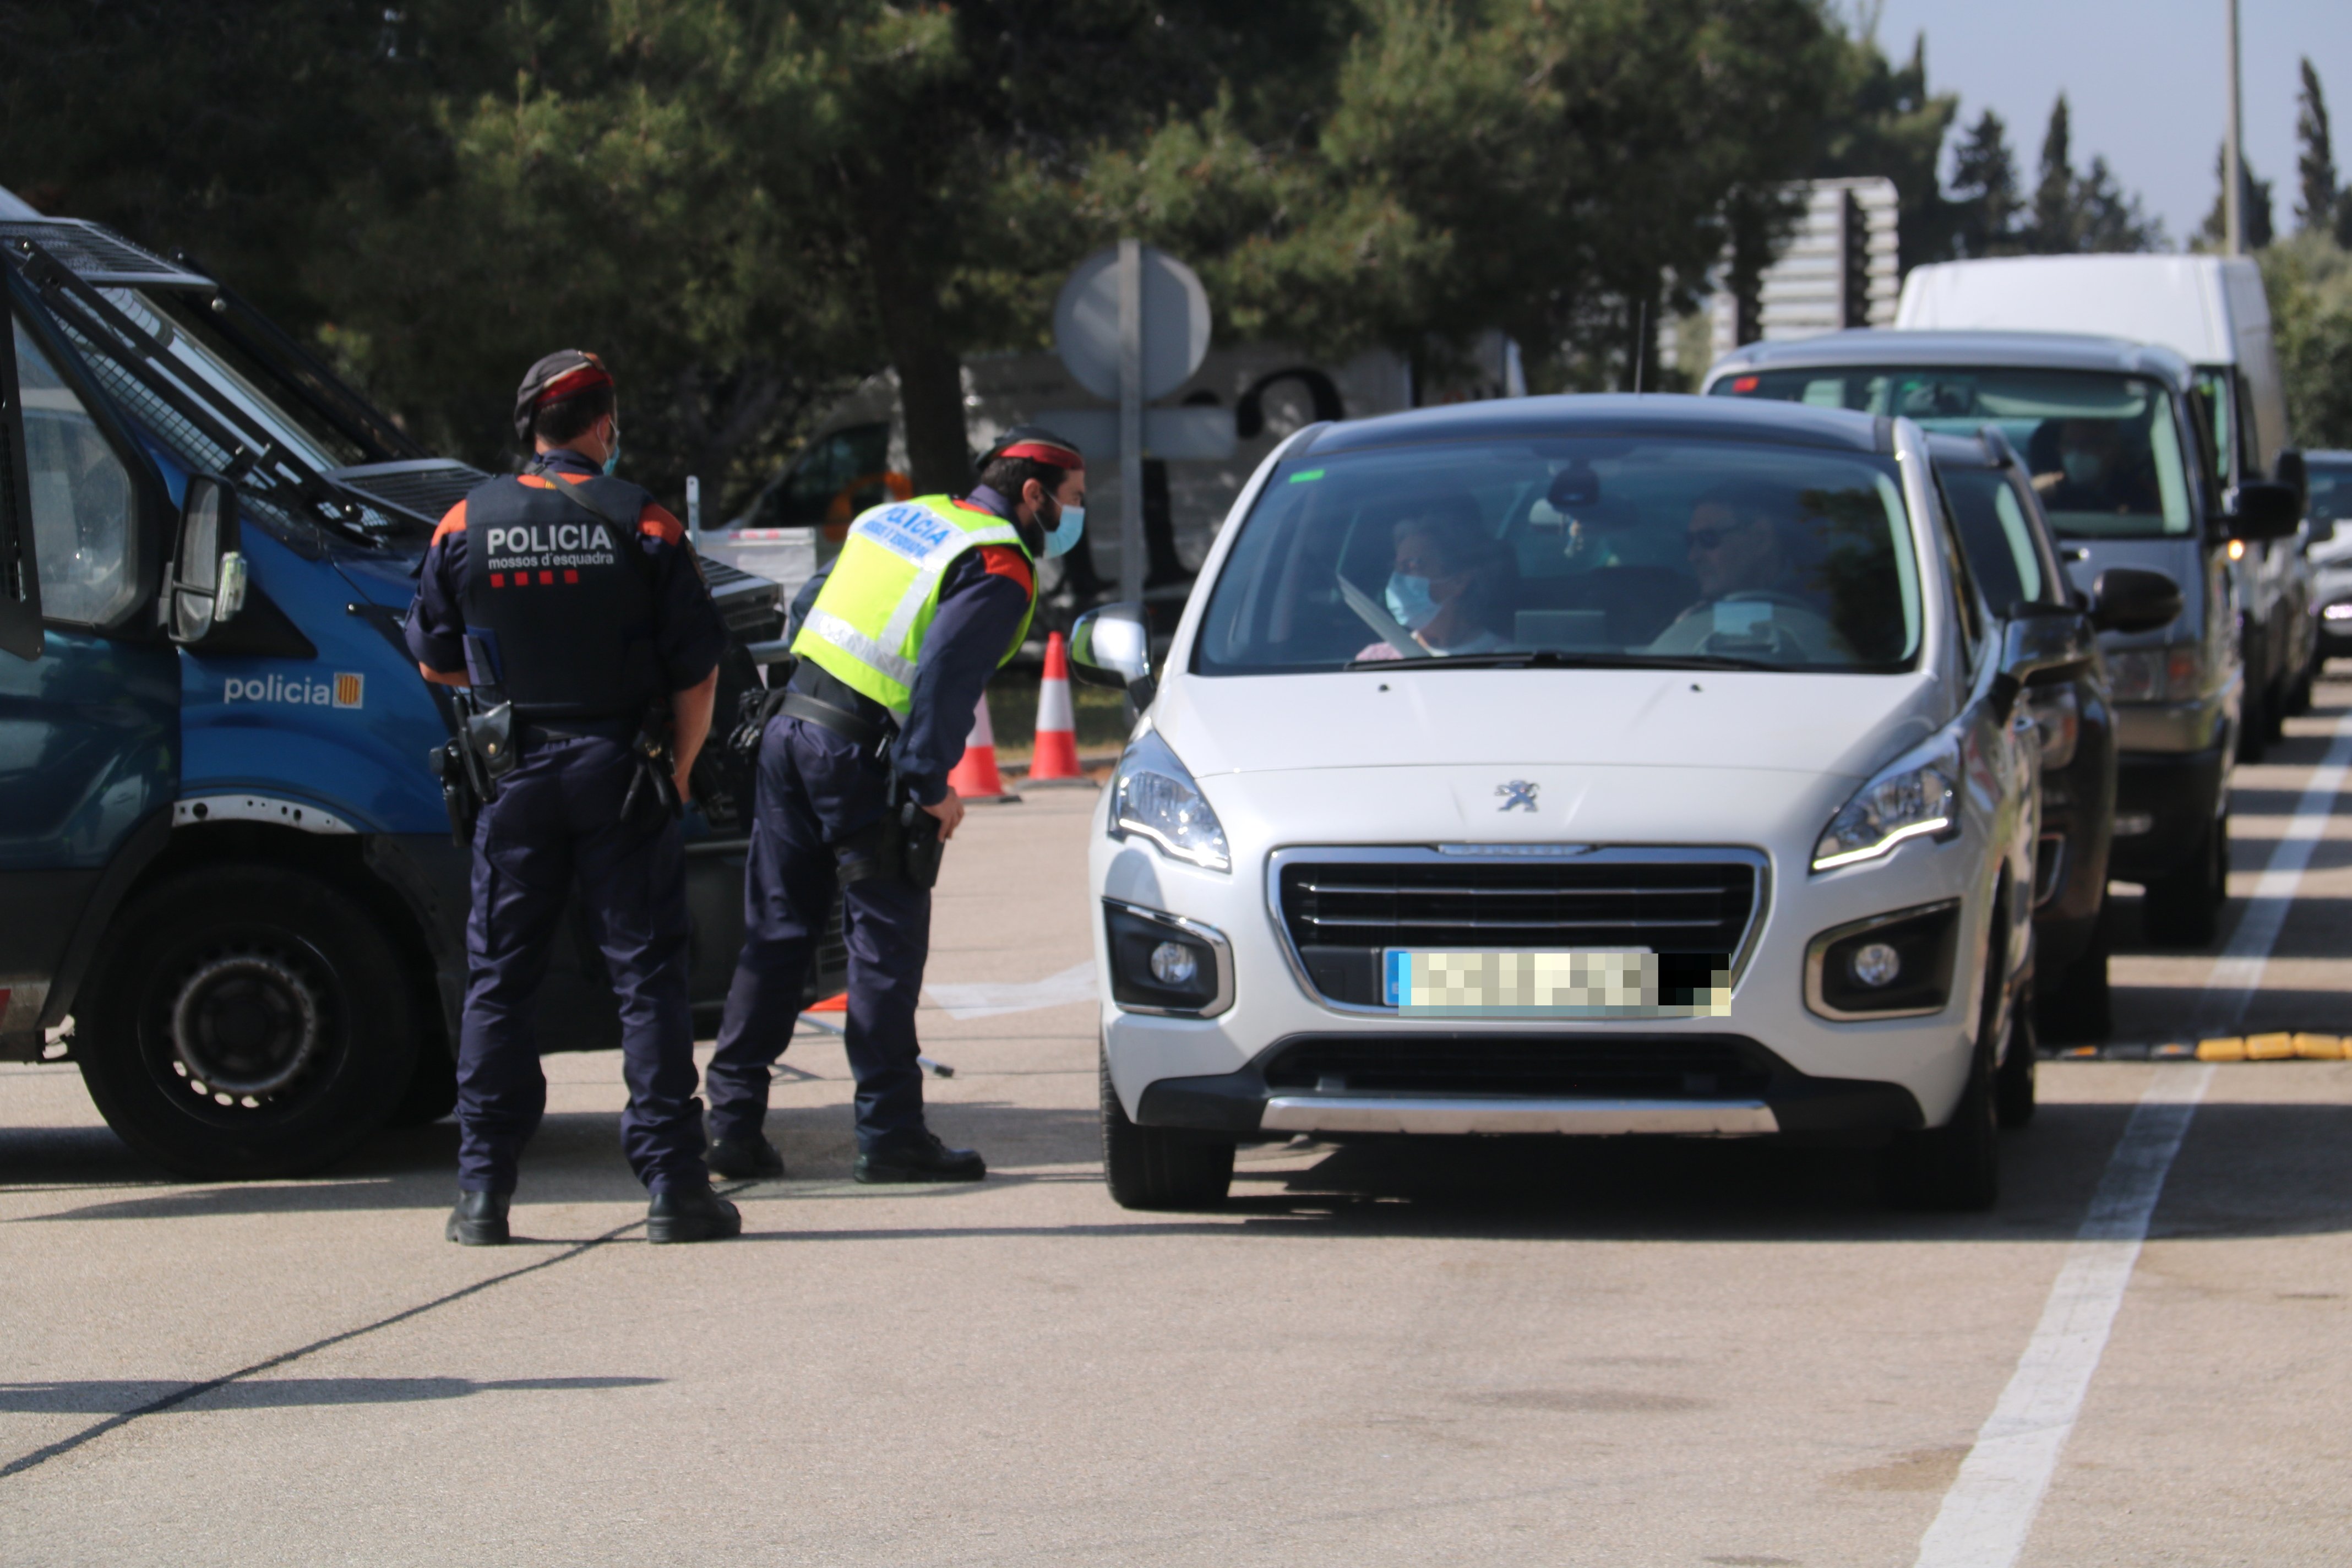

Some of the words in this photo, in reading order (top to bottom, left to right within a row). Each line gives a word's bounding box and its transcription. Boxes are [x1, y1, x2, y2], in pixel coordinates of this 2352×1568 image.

[487, 524, 612, 555] POLICIA
[884, 507, 950, 546] OLICIA
[488, 557, 538, 569] mossos
[224, 673, 330, 705] policia
